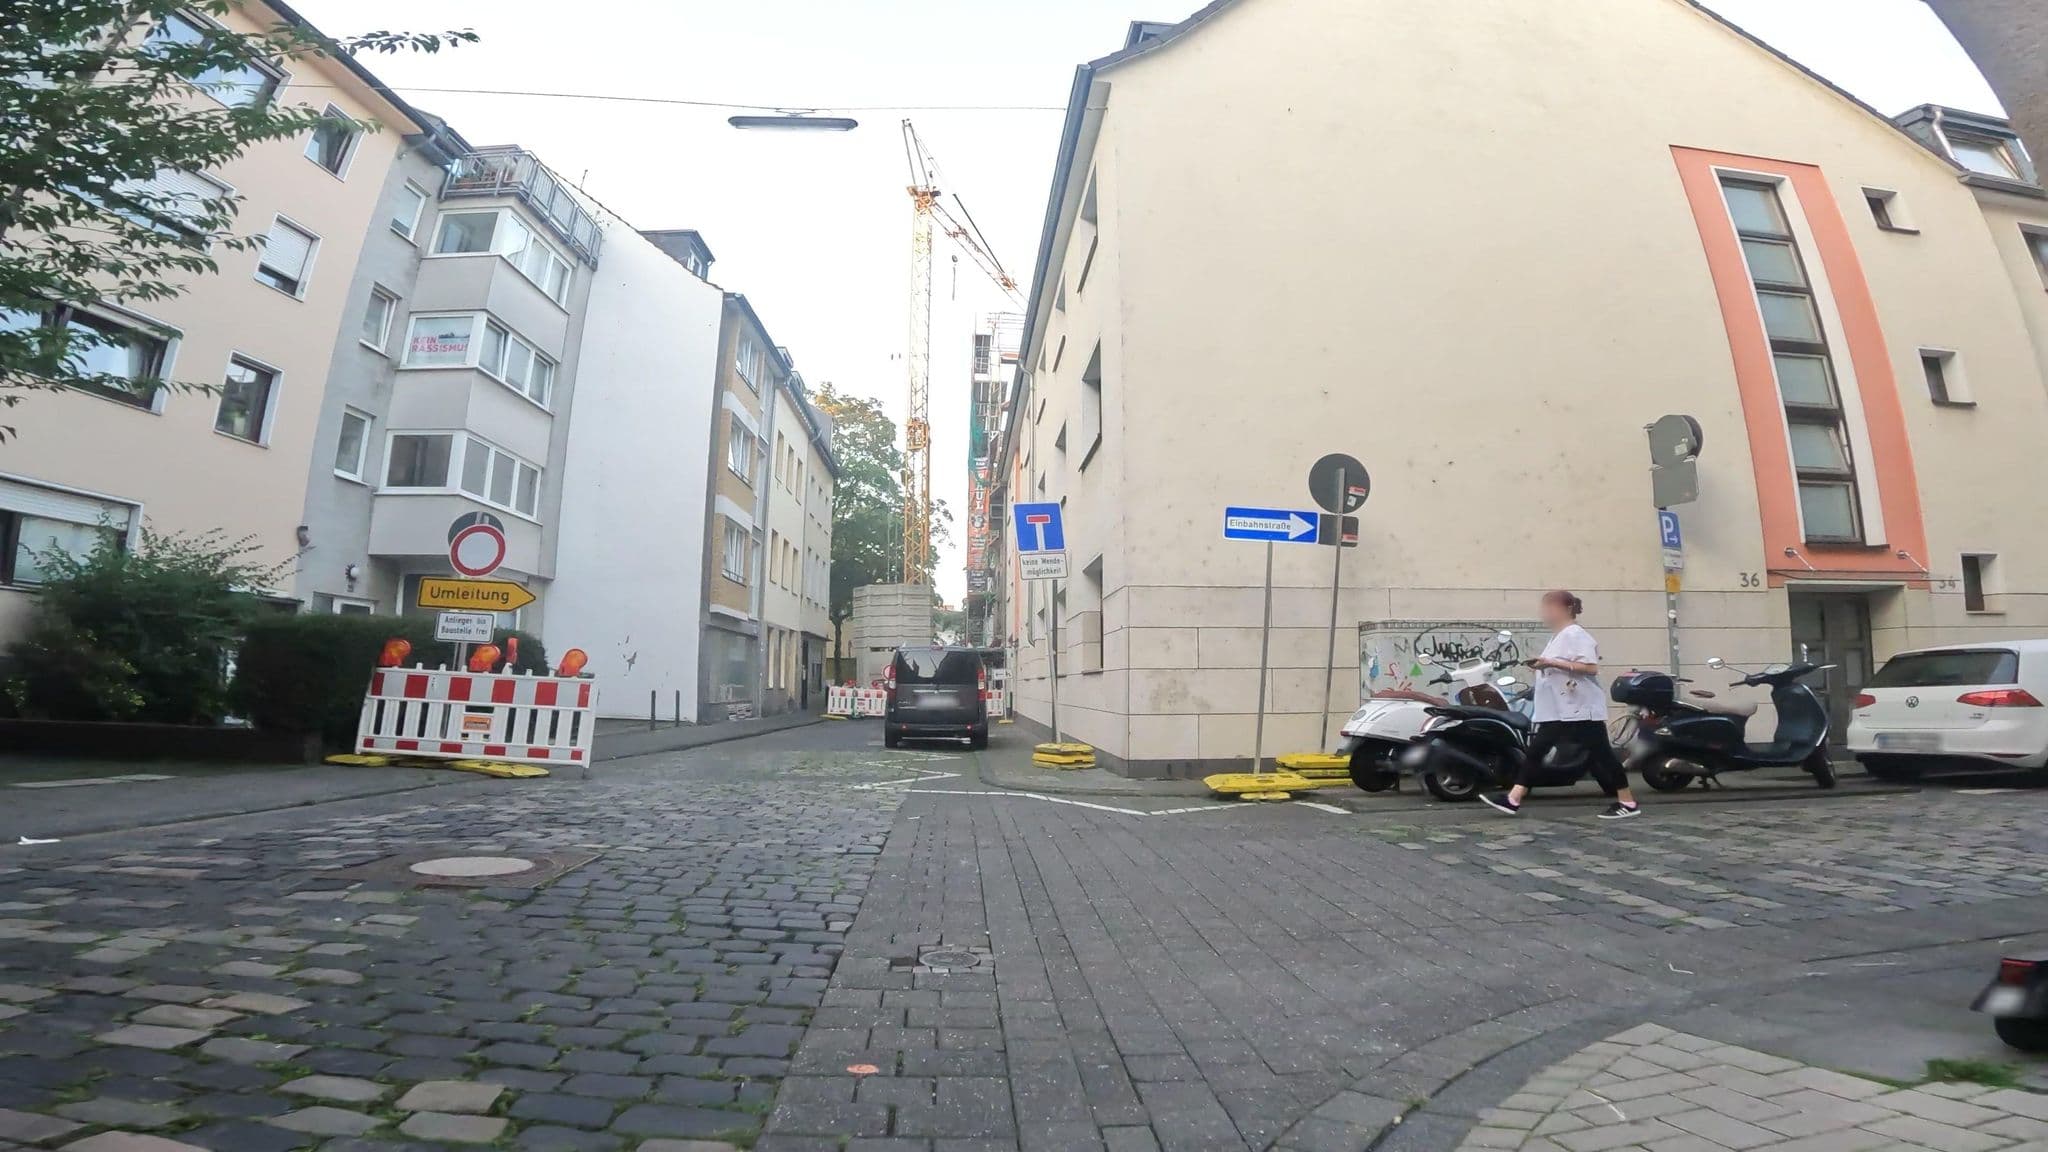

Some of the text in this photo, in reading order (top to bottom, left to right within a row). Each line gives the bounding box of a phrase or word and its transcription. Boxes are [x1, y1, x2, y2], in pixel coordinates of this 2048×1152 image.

[1229, 519, 1291, 531] Einbahnstraße
[1739, 572, 1760, 588] 36
[430, 586, 510, 605] Umleitung
[445, 616, 472, 625] Anlieger
[441, 626, 488, 635] Baustelle frei
